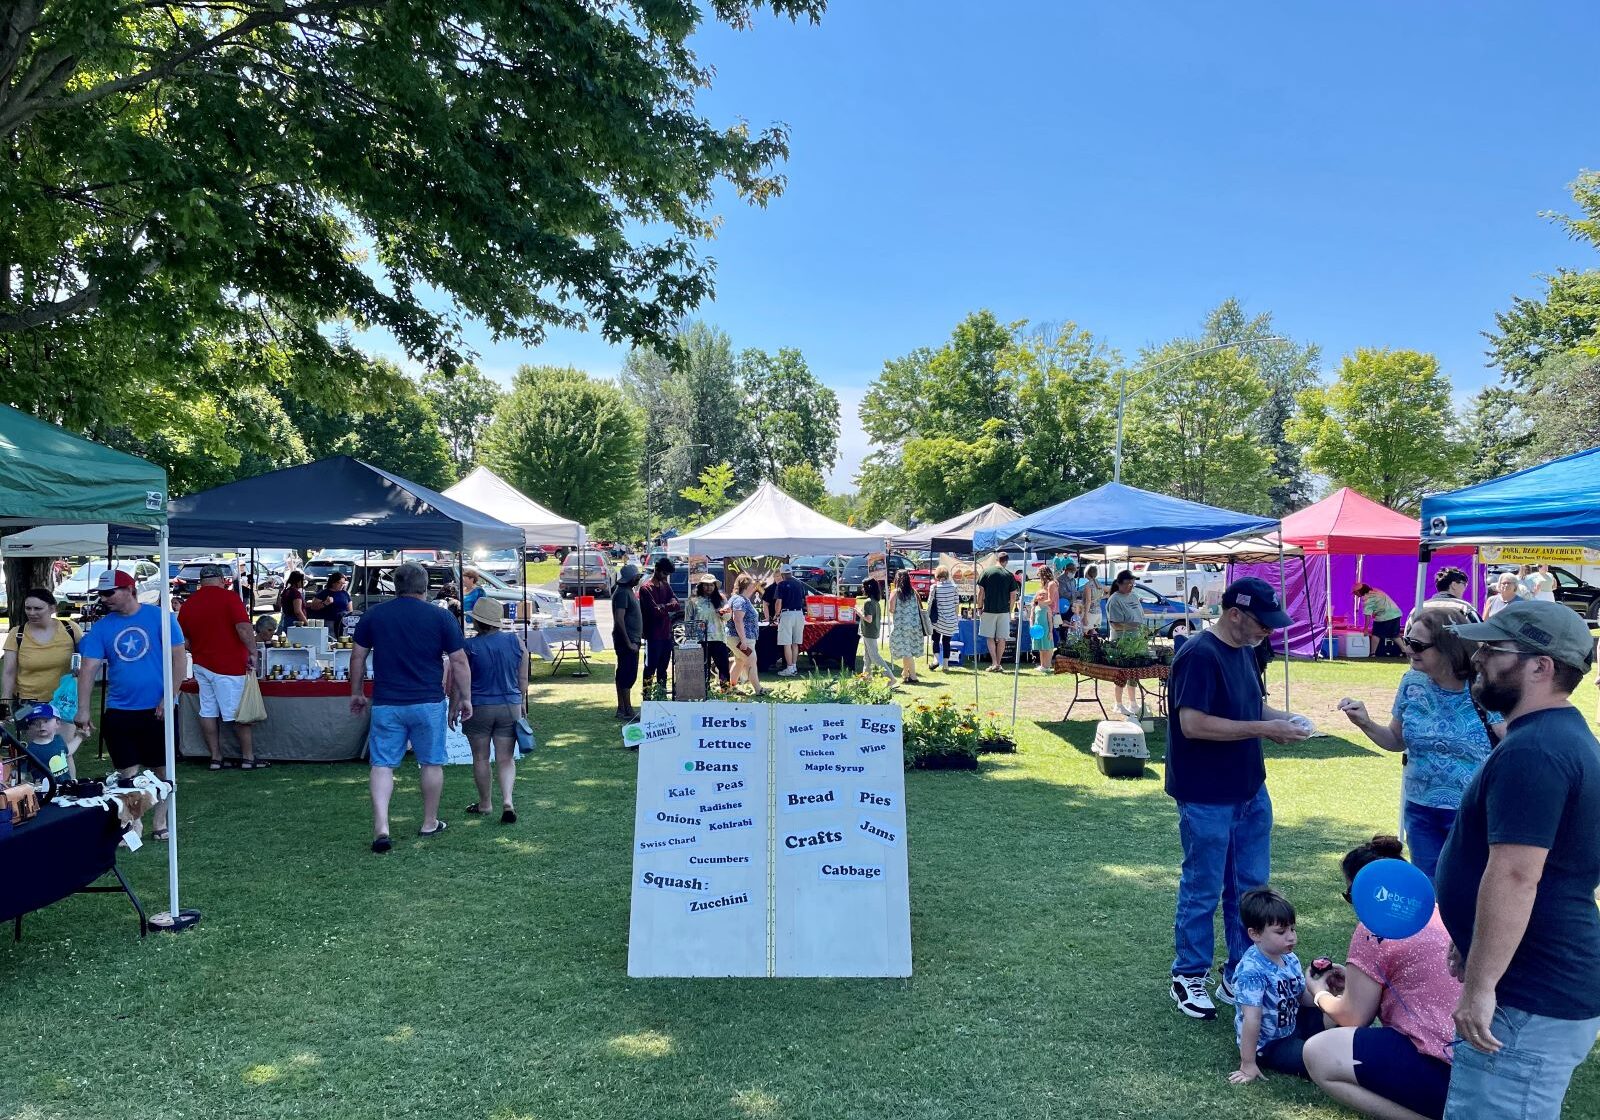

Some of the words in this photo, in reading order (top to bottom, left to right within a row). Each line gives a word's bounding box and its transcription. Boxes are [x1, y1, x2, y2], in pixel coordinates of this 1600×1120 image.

[701, 716, 747, 728] Herbs
[822, 719, 845, 727] Beef
[860, 718, 896, 735] Eggs
[645, 726, 677, 739] MARKET
[788, 724, 814, 734] Meat
[822, 732, 848, 742] Pork
[698, 738, 752, 749] Lettuce
[859, 744, 886, 754] Wine
[799, 749, 835, 757] Chicken
[694, 760, 739, 772] Beans
[804, 763, 834, 772] Maple
[835, 764, 865, 773] Syrup
[716, 780, 744, 792] Peas
[668, 787, 696, 798] Kale
[787, 790, 835, 806] Bread
[859, 791, 892, 807] Pies
[699, 802, 743, 813] Radishes
[656, 810, 703, 826] Onions
[708, 818, 753, 831] Kohlrabi
[859, 820, 896, 842] Jams
[639, 840, 667, 850] Swiss
[667, 835, 696, 846] Chard
[784, 830, 843, 849] Crafts
[689, 855, 749, 865] Cucumbers
[821, 864, 881, 878] Cabbage
[689, 892, 749, 912] Zucchini
